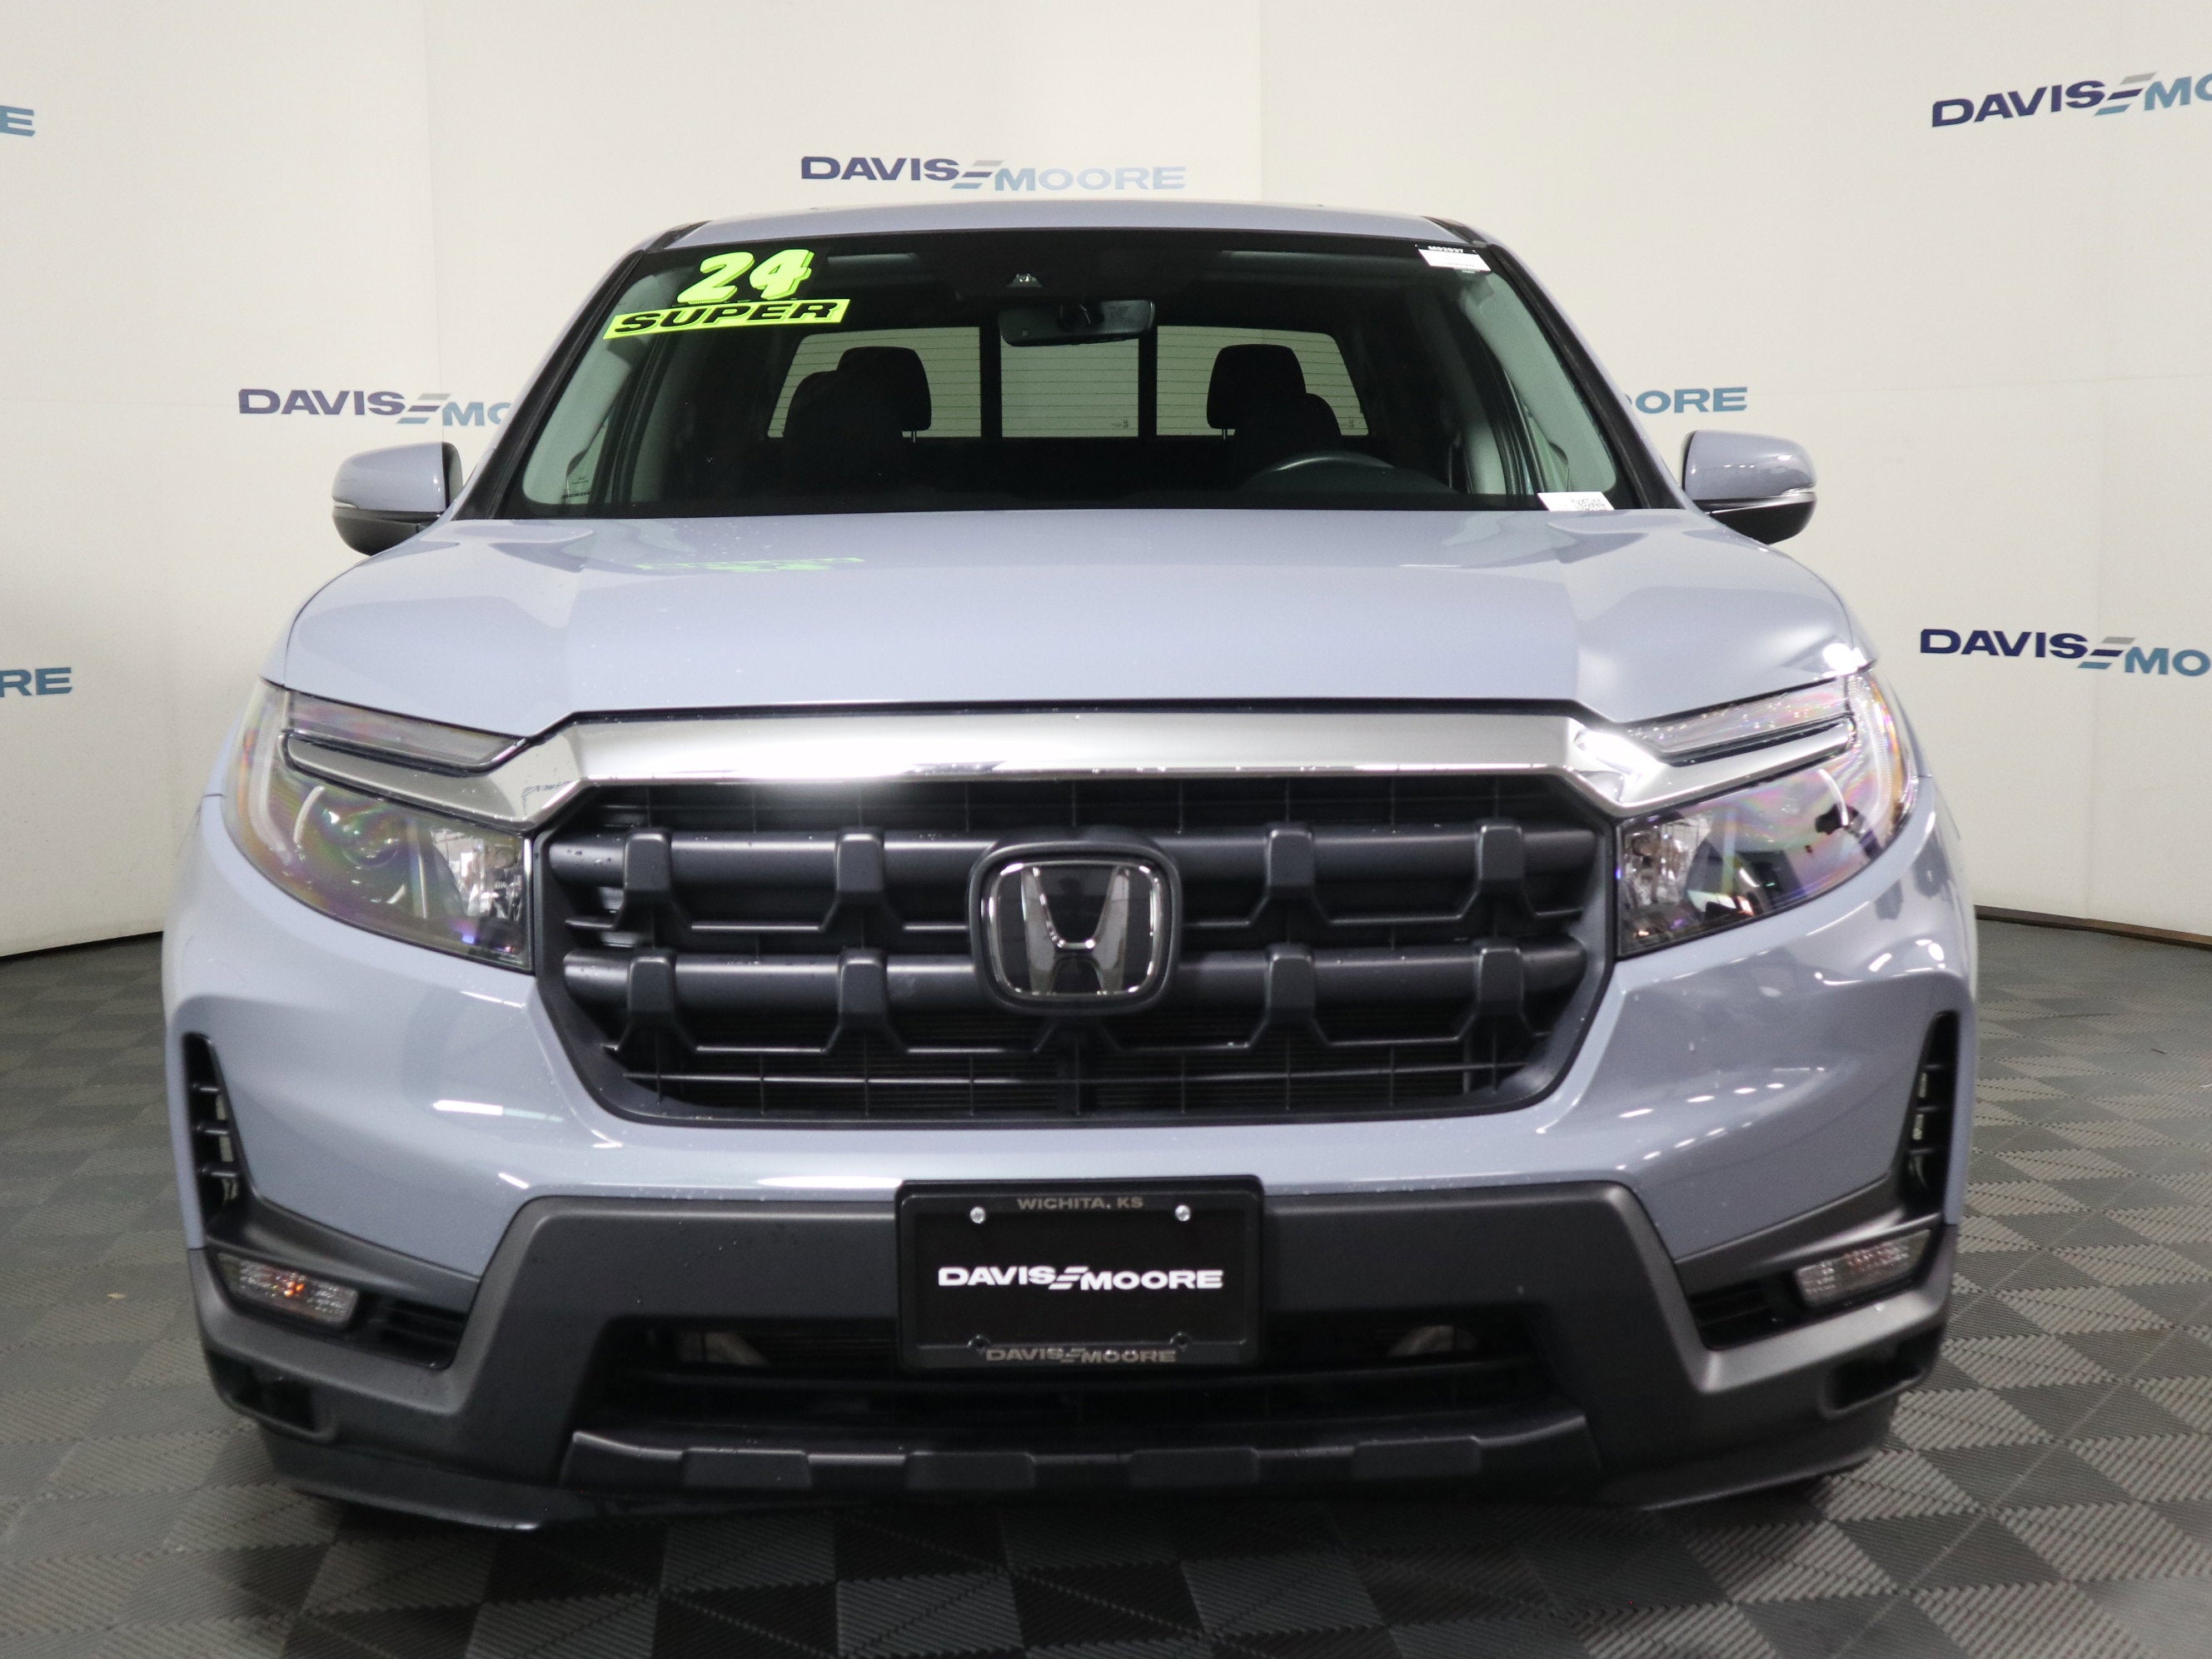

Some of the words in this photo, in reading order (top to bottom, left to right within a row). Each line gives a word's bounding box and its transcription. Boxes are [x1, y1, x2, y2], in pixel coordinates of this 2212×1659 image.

[1931, 80, 2106, 127] DAVIS
[800, 156, 959, 181] DAVIS
[994, 167, 1186, 192] MOORE
[676, 249, 815, 301] 24
[615, 301, 839, 333] SUPER
[238, 389, 406, 416] DAVIS
[1625, 386, 1748, 414] ORE
[1920, 629, 2089, 659] DAVIS
[1117, 1197, 1144, 1209] KS
[938, 1266, 1056, 1286] DAVIS
[1080, 1270, 1223, 1290] MOORE
[986, 1348, 1064, 1362] DAVIS
[1081, 1350, 1177, 1363] MOORE
